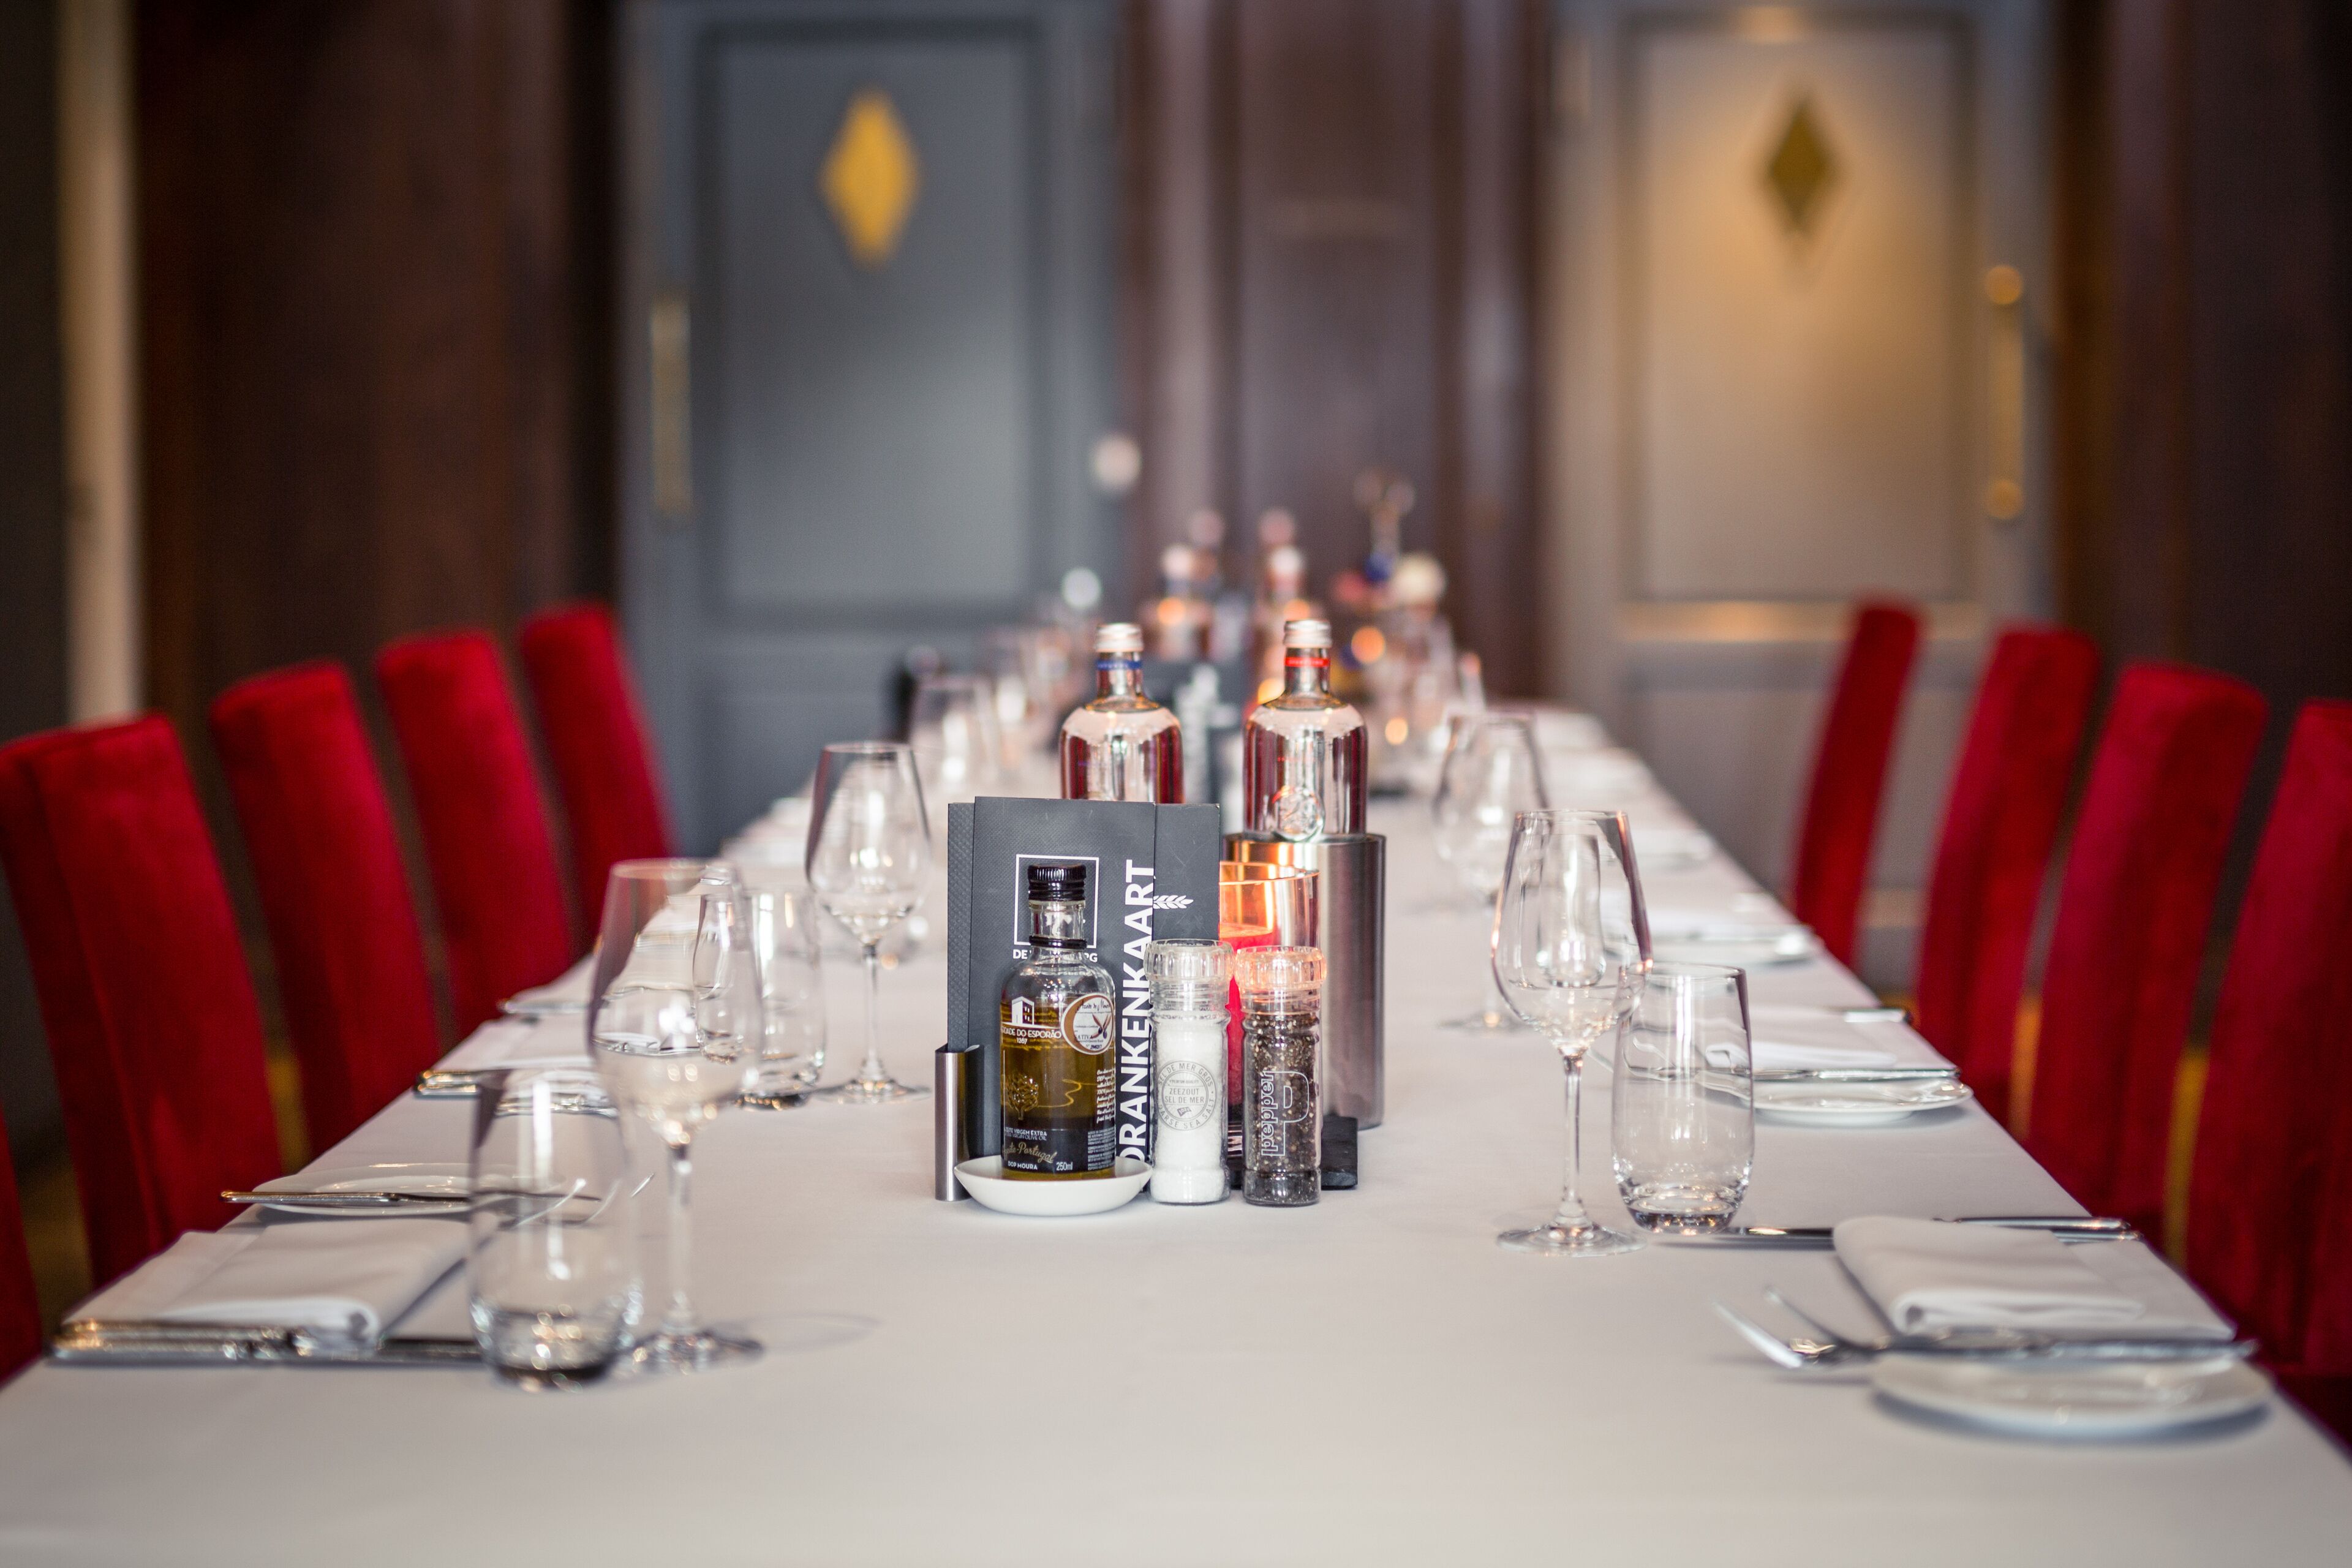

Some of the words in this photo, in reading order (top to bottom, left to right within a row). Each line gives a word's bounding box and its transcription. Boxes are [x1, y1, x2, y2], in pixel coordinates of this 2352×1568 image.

[1013, 949, 1028, 960] DE
[1028, 1030, 1062, 1039] ESPORÃO
[1166, 1065, 1176, 1074] DE
[1179, 1063, 1196, 1071] MER
[1198, 1068, 1213, 1087] GROS
[1158, 1099, 1179, 1128] OARSE
[1202, 1098, 1214, 1120] SALT
[1261, 1071, 1279, 1156] pepper
[1056, 1161, 1073, 1171] 250ml
